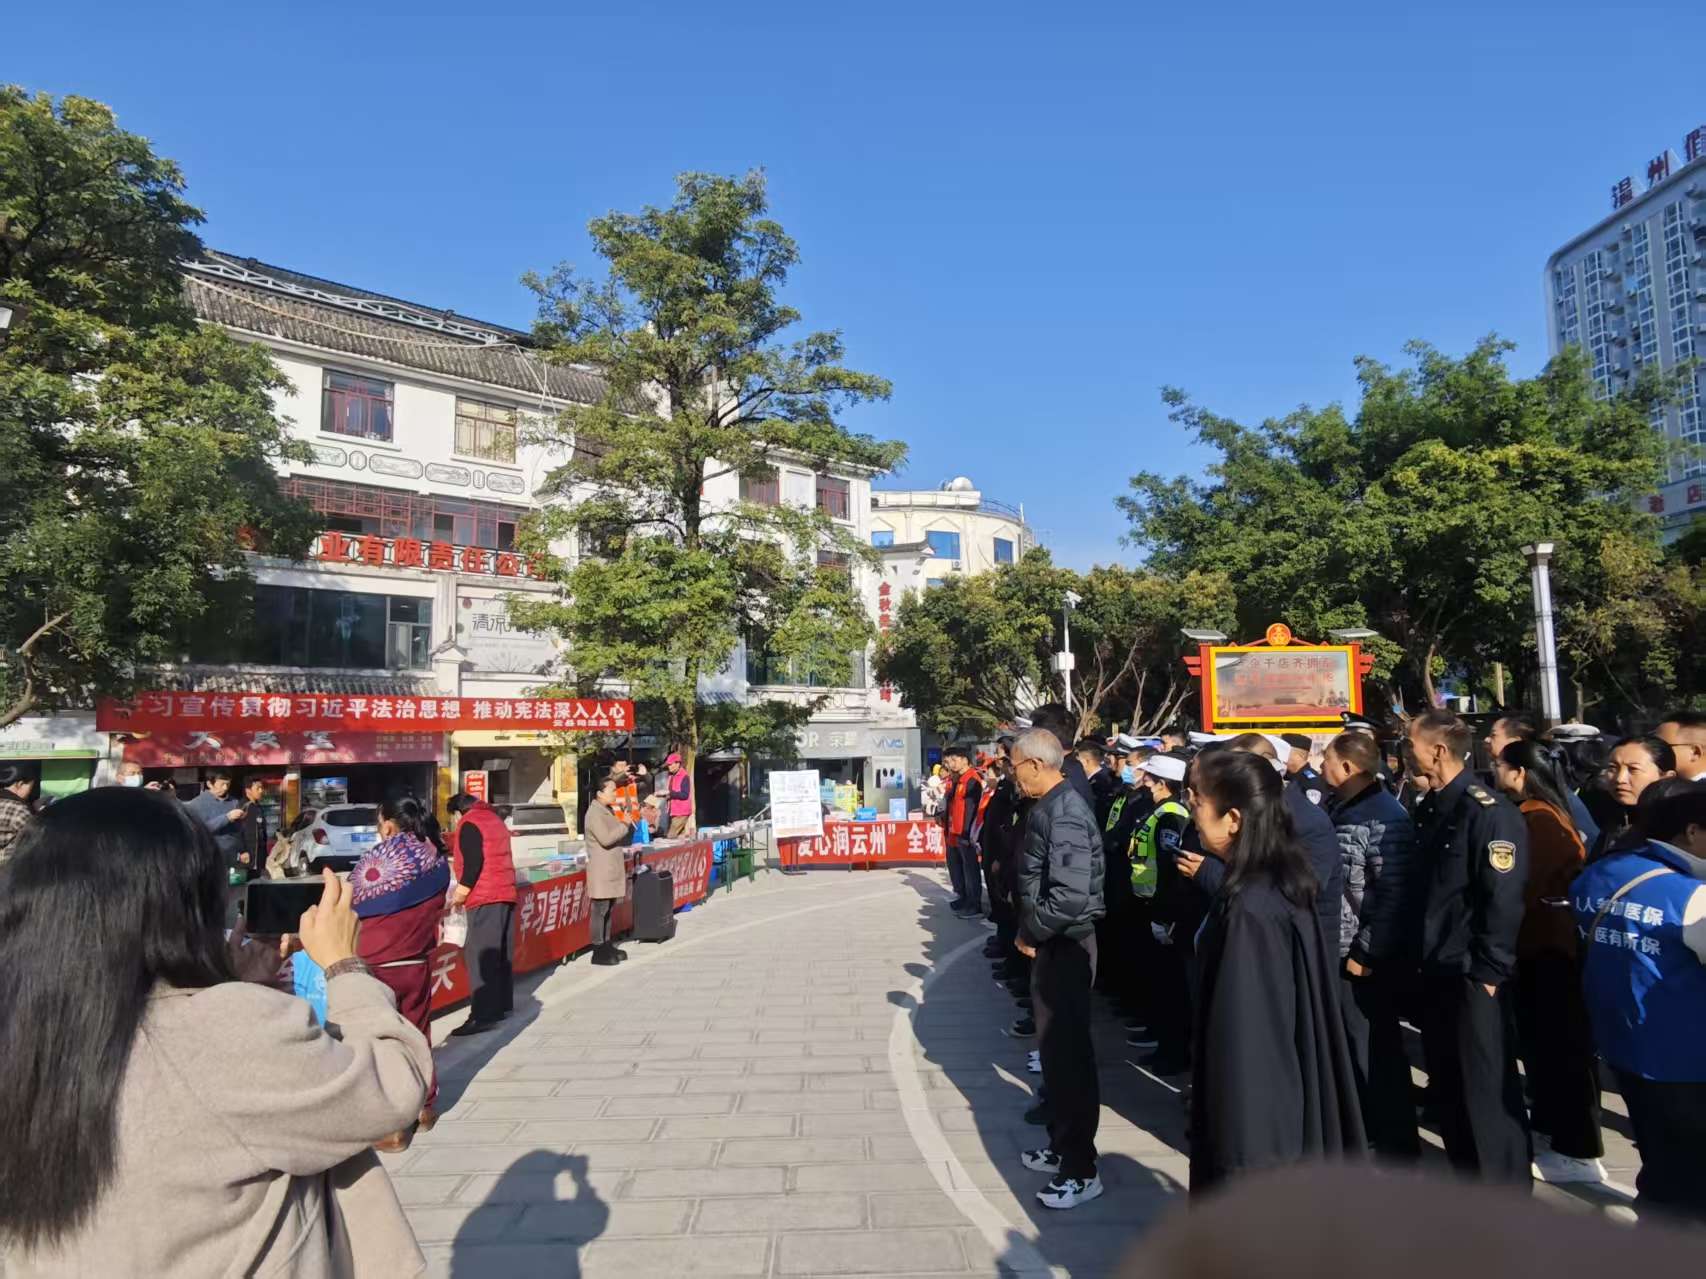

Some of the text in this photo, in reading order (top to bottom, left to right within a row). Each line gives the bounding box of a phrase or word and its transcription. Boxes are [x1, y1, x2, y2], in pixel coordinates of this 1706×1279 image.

[472, 701, 625, 720] 推动宪法深入人心
